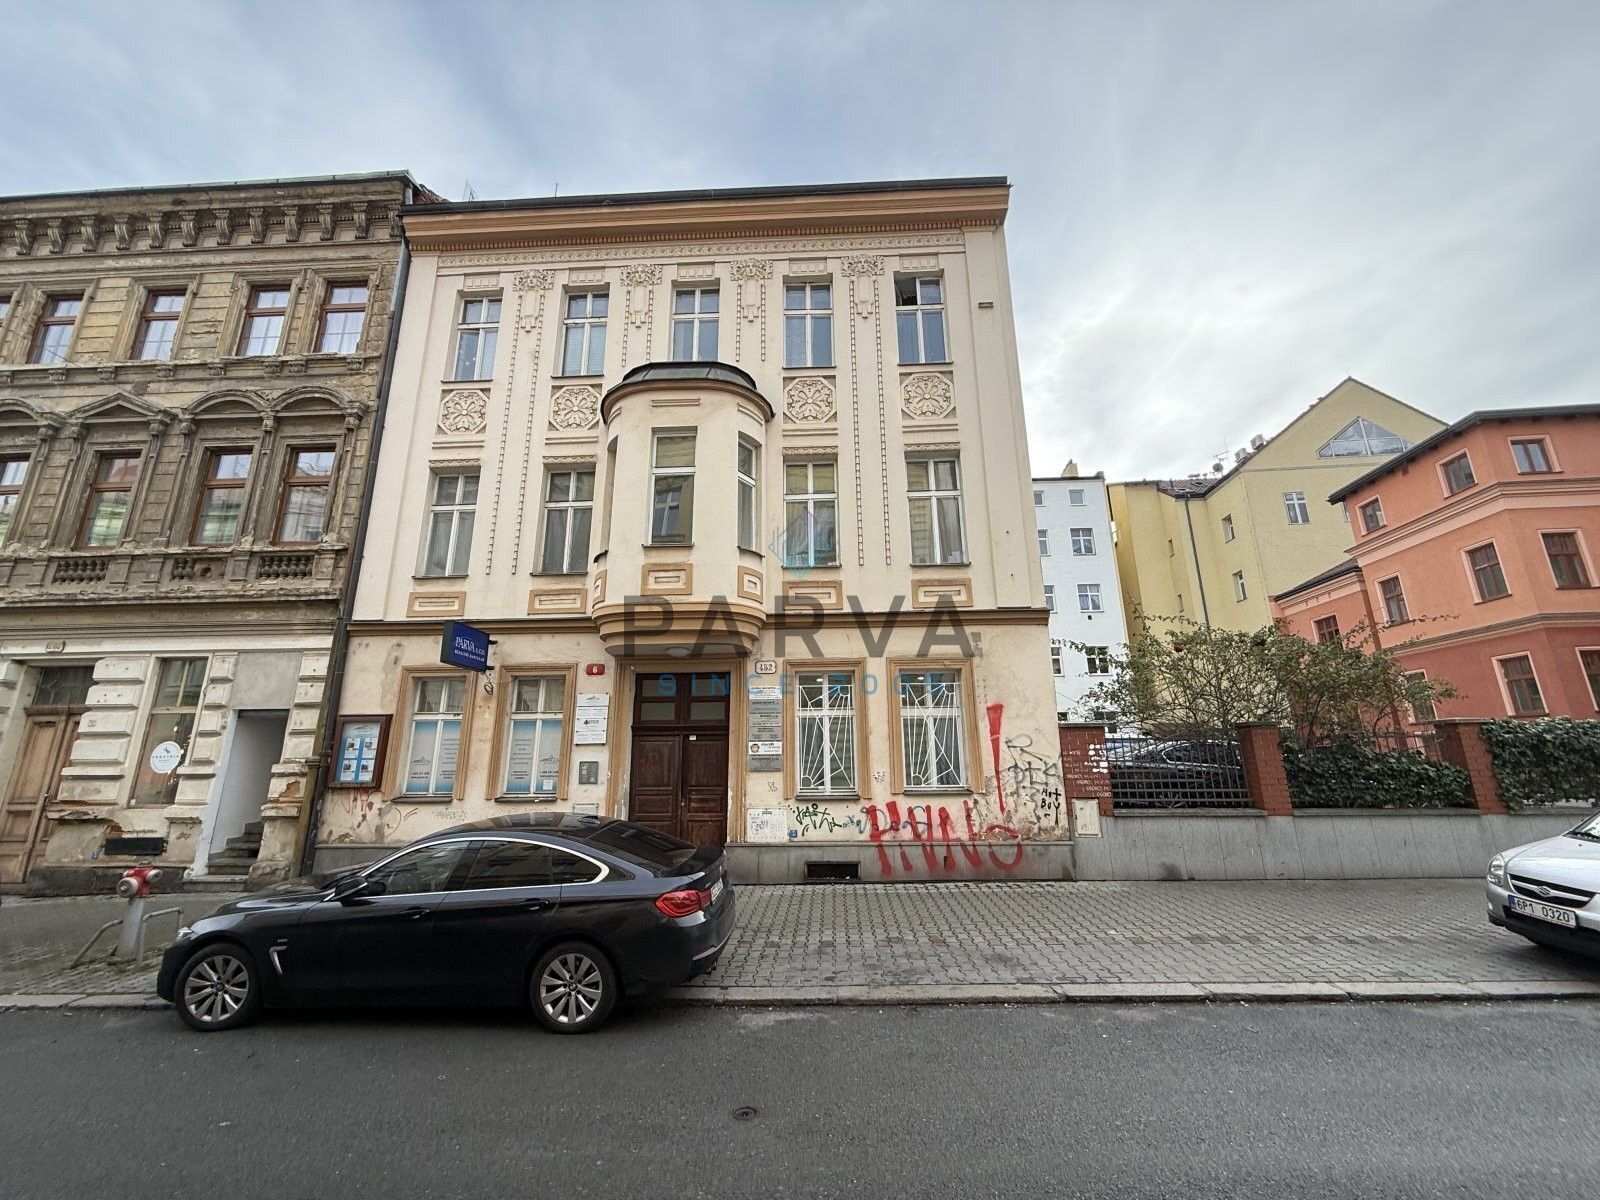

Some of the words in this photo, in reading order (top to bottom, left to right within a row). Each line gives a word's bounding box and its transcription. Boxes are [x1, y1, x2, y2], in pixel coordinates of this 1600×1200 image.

[455, 636, 476, 653] PARVA
[592, 666, 599, 674] 6
[1516, 899, 1535, 914] 6P1
[1541, 906, 1570, 923] 0320
